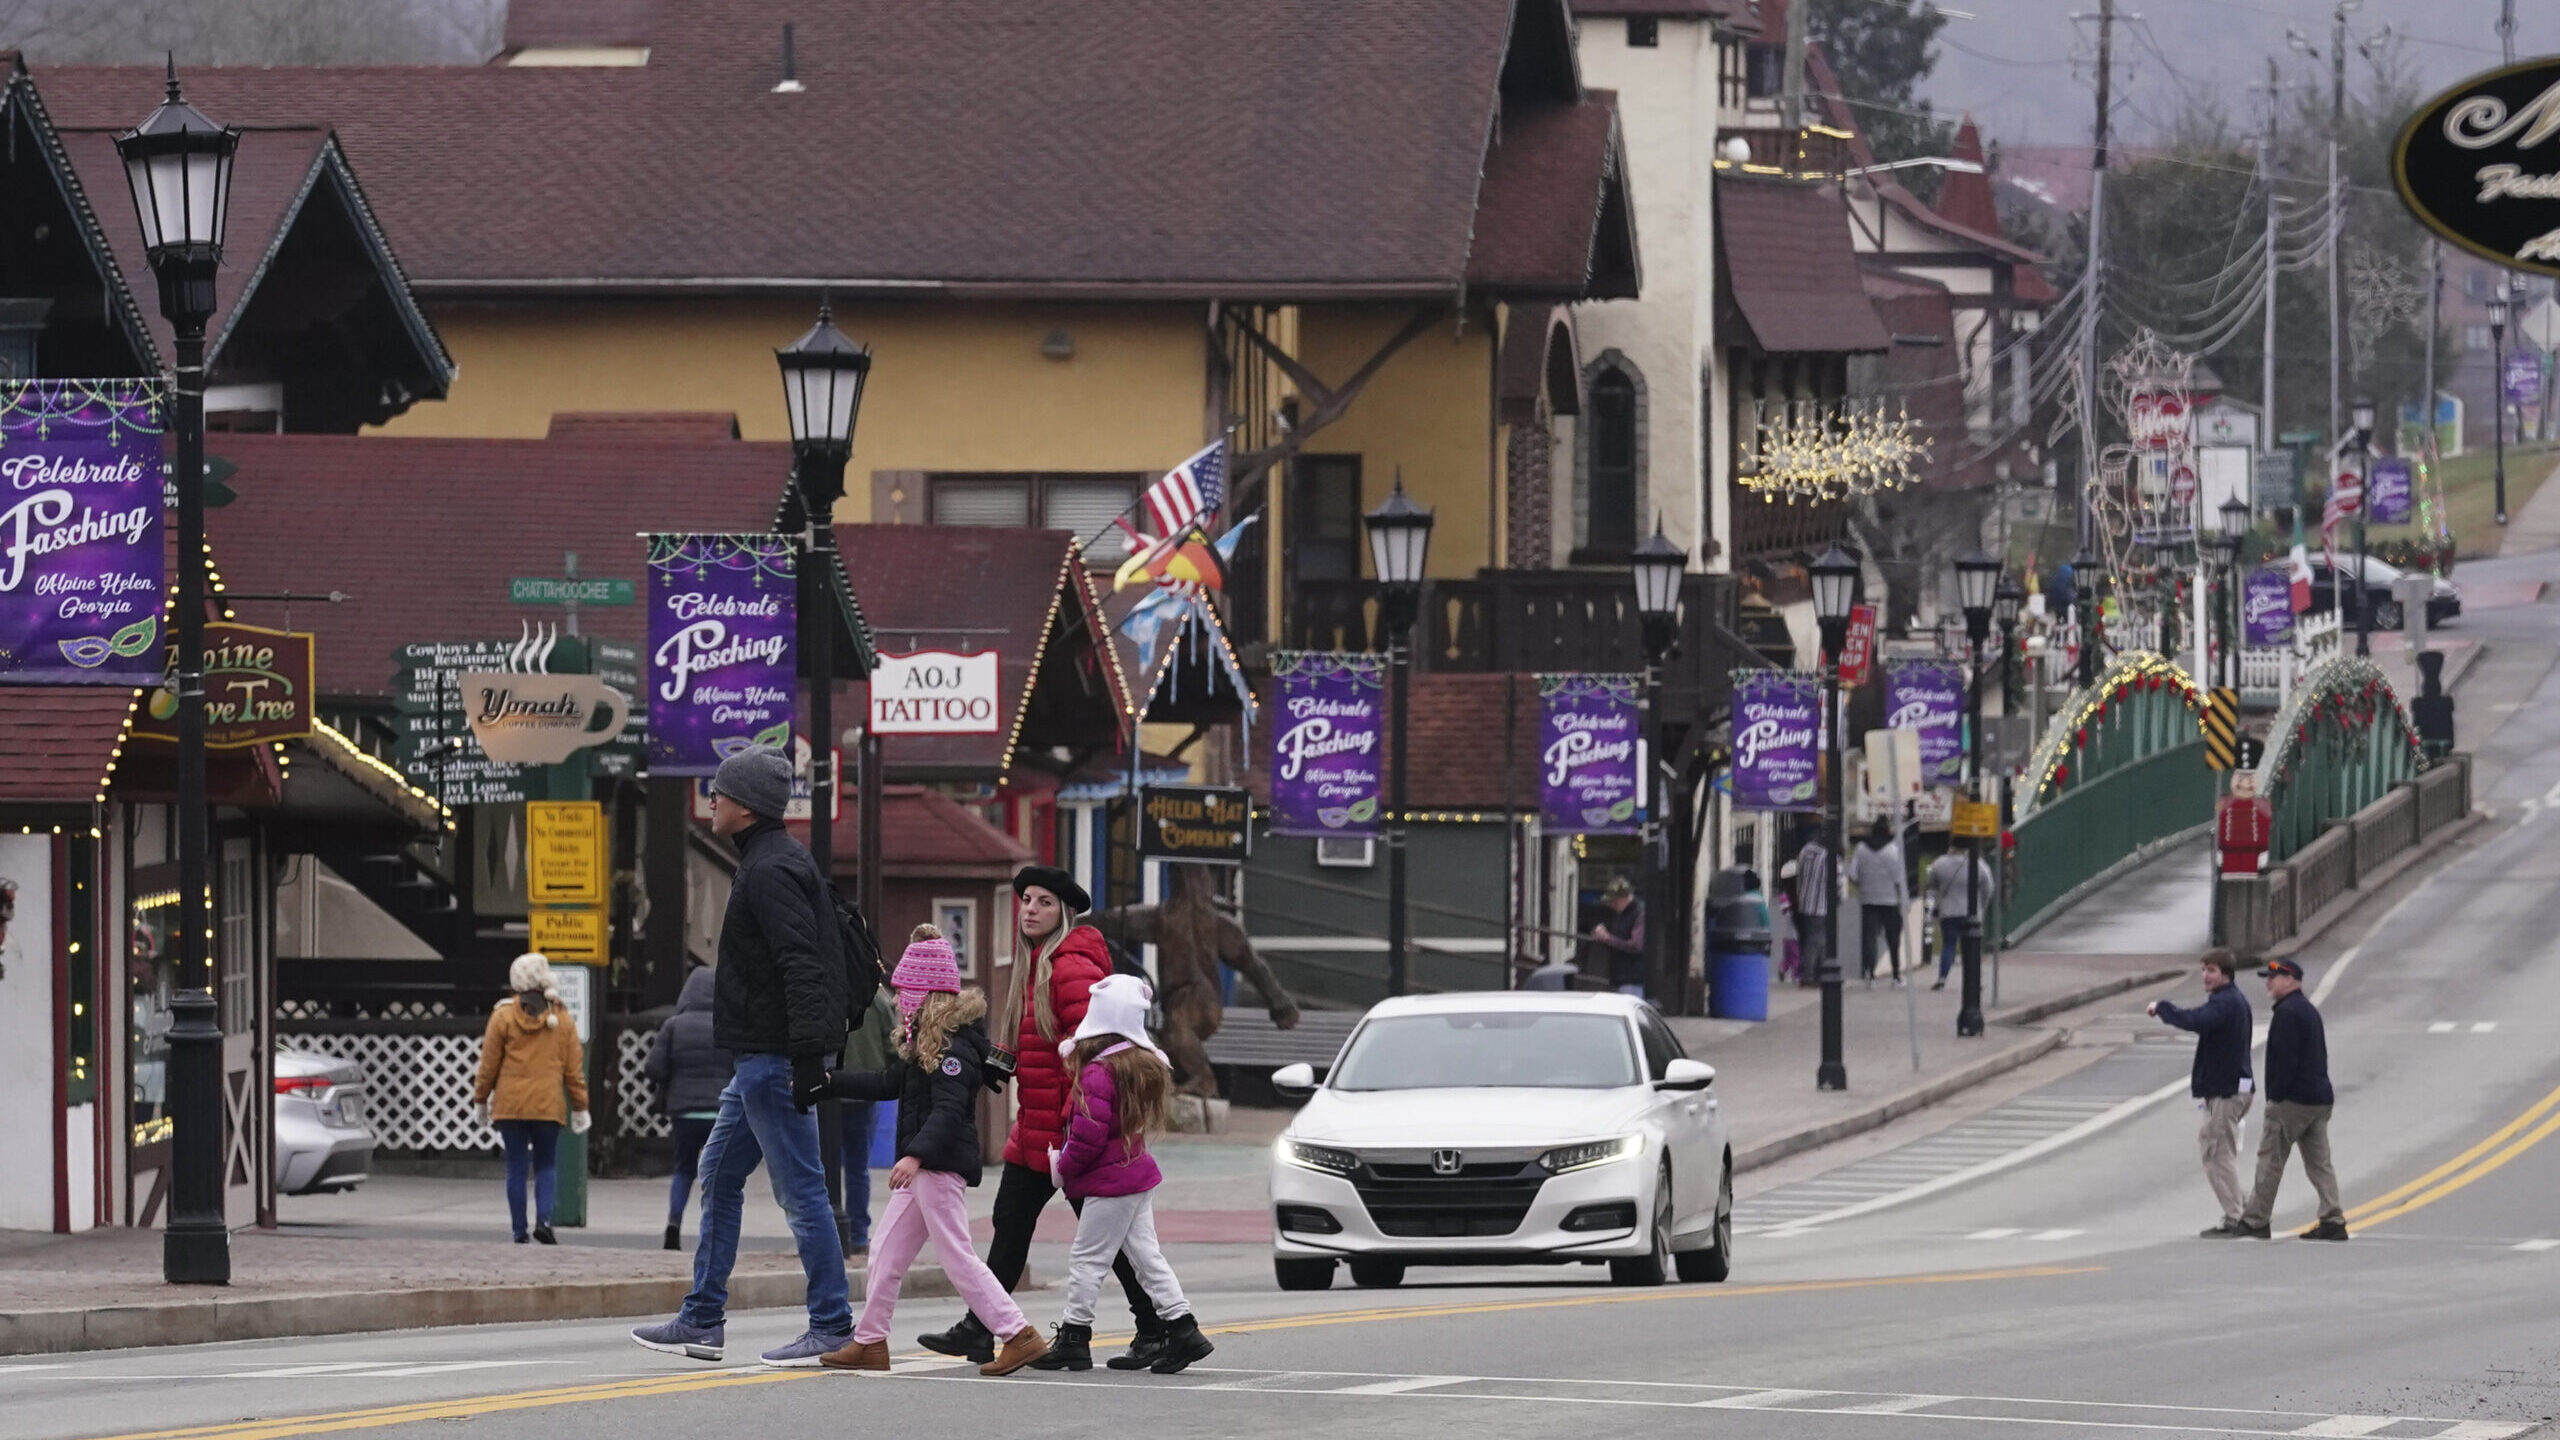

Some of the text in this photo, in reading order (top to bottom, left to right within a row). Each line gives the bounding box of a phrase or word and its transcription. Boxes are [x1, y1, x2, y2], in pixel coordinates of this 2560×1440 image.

[2, 454, 143, 490] Celebrate
[0, 489, 154, 592] Fasching
[34, 572, 97, 597] Alpine
[513, 580, 609, 599] CHATTAHOOCHEE
[58, 596, 133, 620] Georgia
[667, 592, 780, 620] Celebrate
[406, 642, 470, 657] Cowboys
[475, 642, 487, 653] &
[655, 620, 787, 701] Fasching
[904, 666, 962, 689] AOJ
[226, 678, 296, 723] Tree
[478, 688, 583, 726] Yonah
[693, 686, 742, 705] Alpine
[1288, 696, 1371, 719] Celebrate
[712, 704, 770, 725] Georgia
[874, 696, 991, 721] TATTOO
[1744, 703, 1810, 722] Celebrate
[539, 720, 581, 729] COMPANY
[1552, 712, 1627, 734] Celebrate
[1277, 718, 1376, 780] Fasching
[1736, 719, 1813, 769] Fasching
[1544, 730, 1632, 787] Fasching
[484, 790, 525, 803] Treats
[1145, 795, 1203, 822] HELEN
[546, 916, 584, 928] Public
[536, 930, 595, 941] Restrooms
